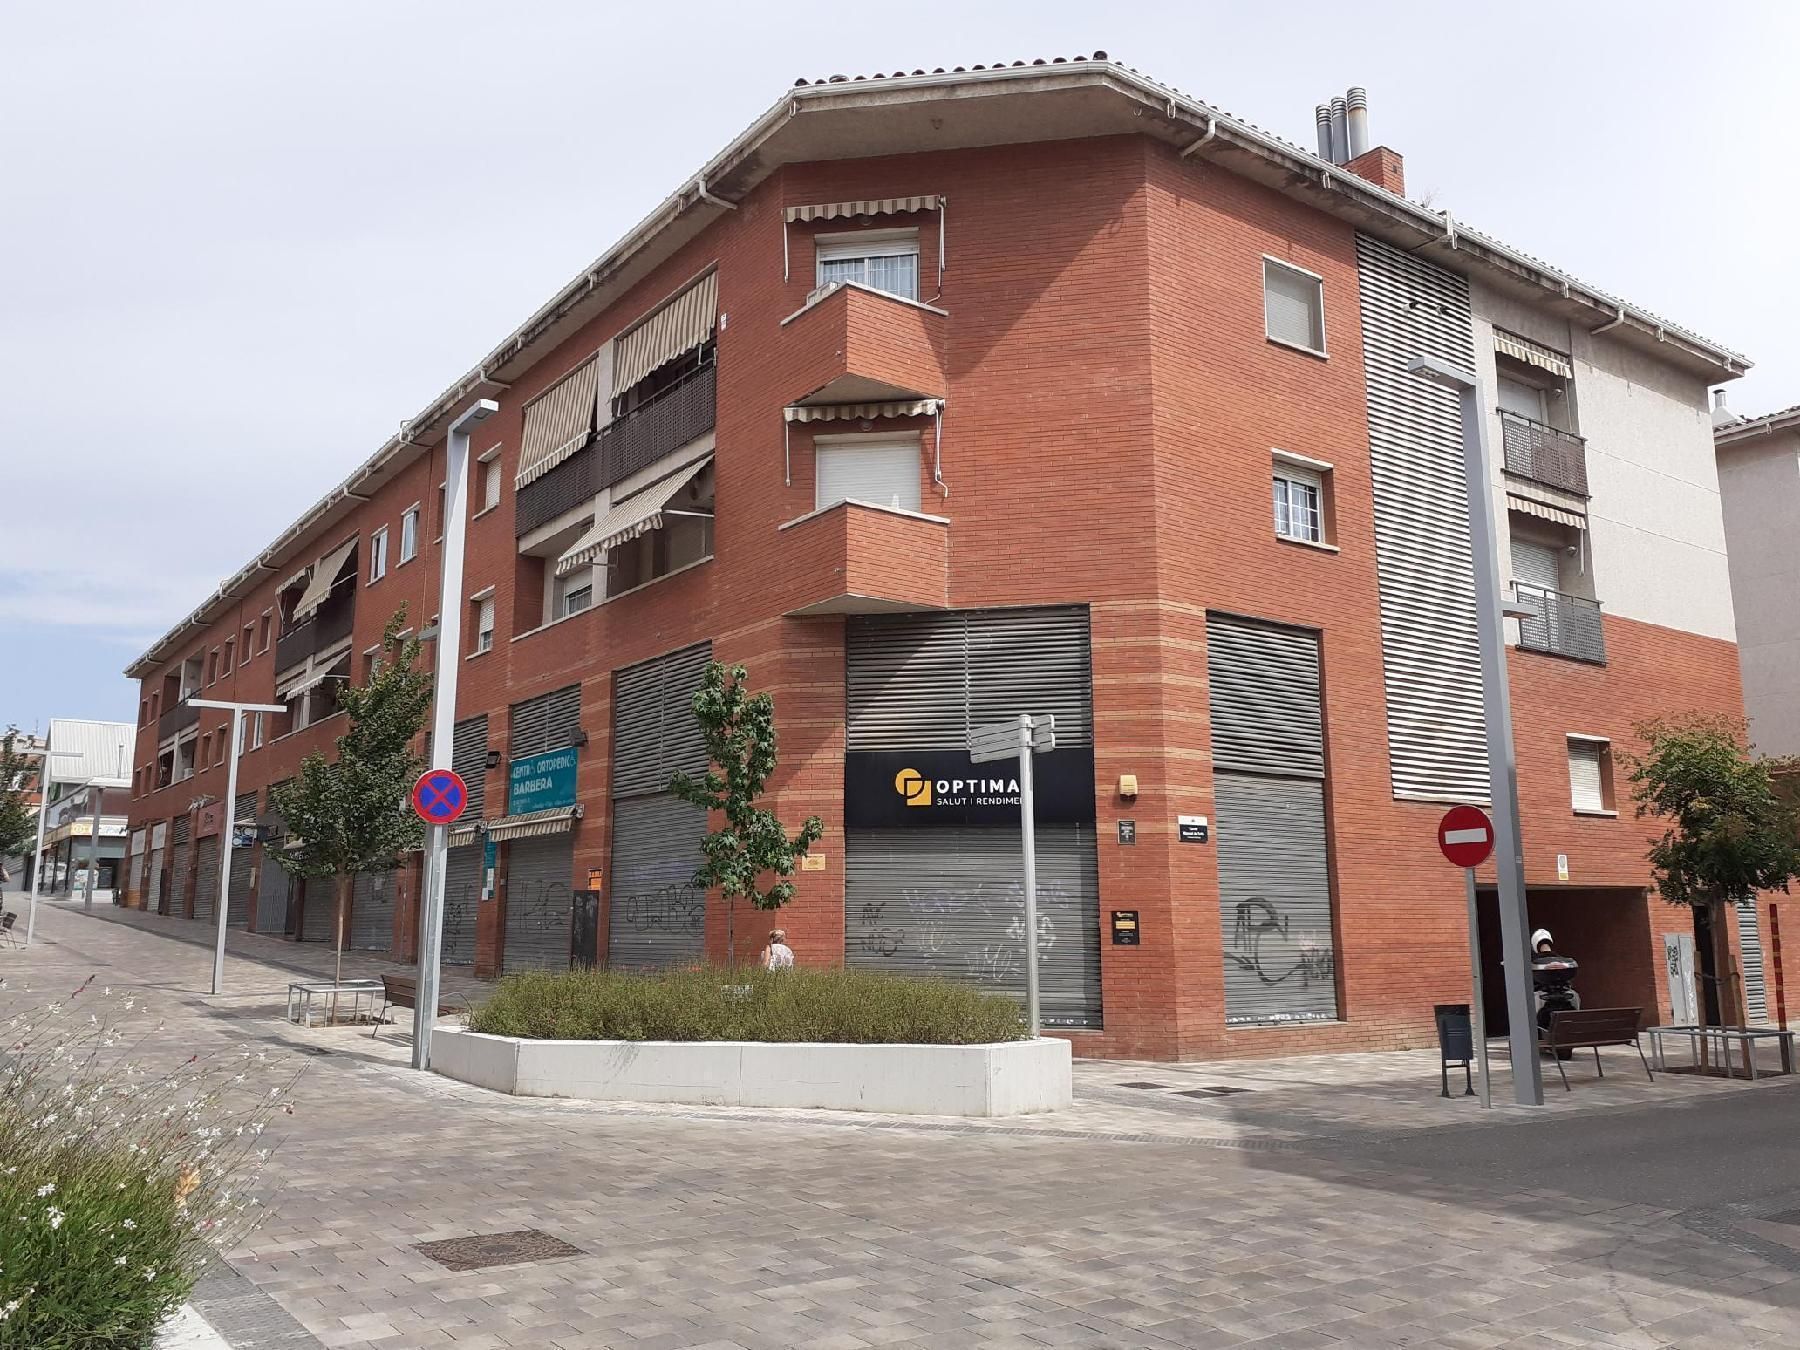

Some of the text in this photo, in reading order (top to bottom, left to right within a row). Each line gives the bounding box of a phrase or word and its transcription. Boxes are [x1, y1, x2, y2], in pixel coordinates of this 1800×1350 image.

[936, 779, 1020, 794] OPTIMA
[936, 797, 1022, 806] SALUT RENDIME
